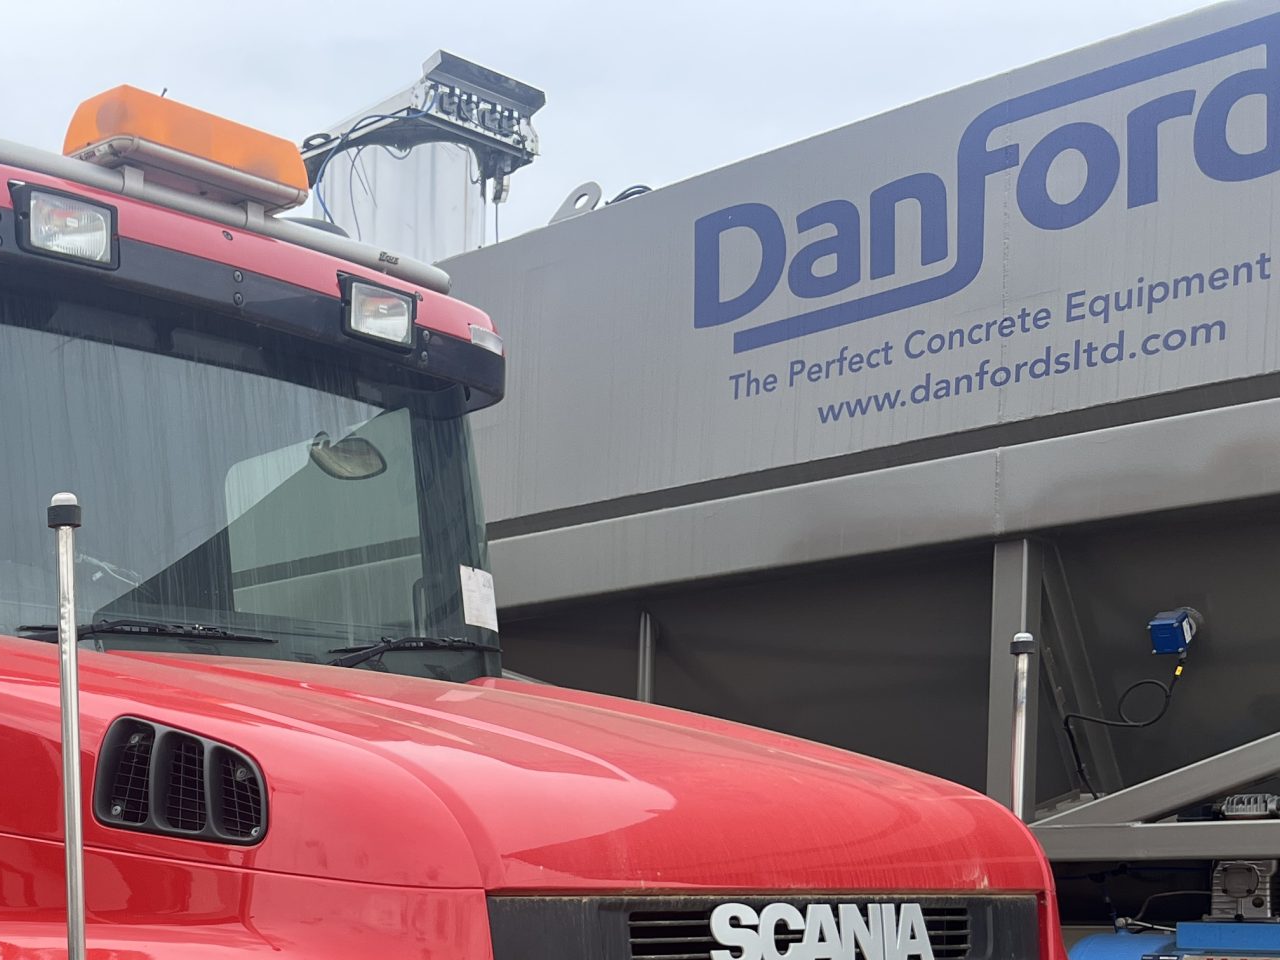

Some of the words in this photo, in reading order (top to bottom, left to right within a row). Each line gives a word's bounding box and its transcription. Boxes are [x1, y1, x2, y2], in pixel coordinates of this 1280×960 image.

[728, 369, 778, 400] The
[789, 341, 894, 387] Perfect
[904, 307, 1052, 360] Concrete
[1066, 252, 1272, 324] Equipment
[817, 319, 1227, 424] www.danfordsltd.com
